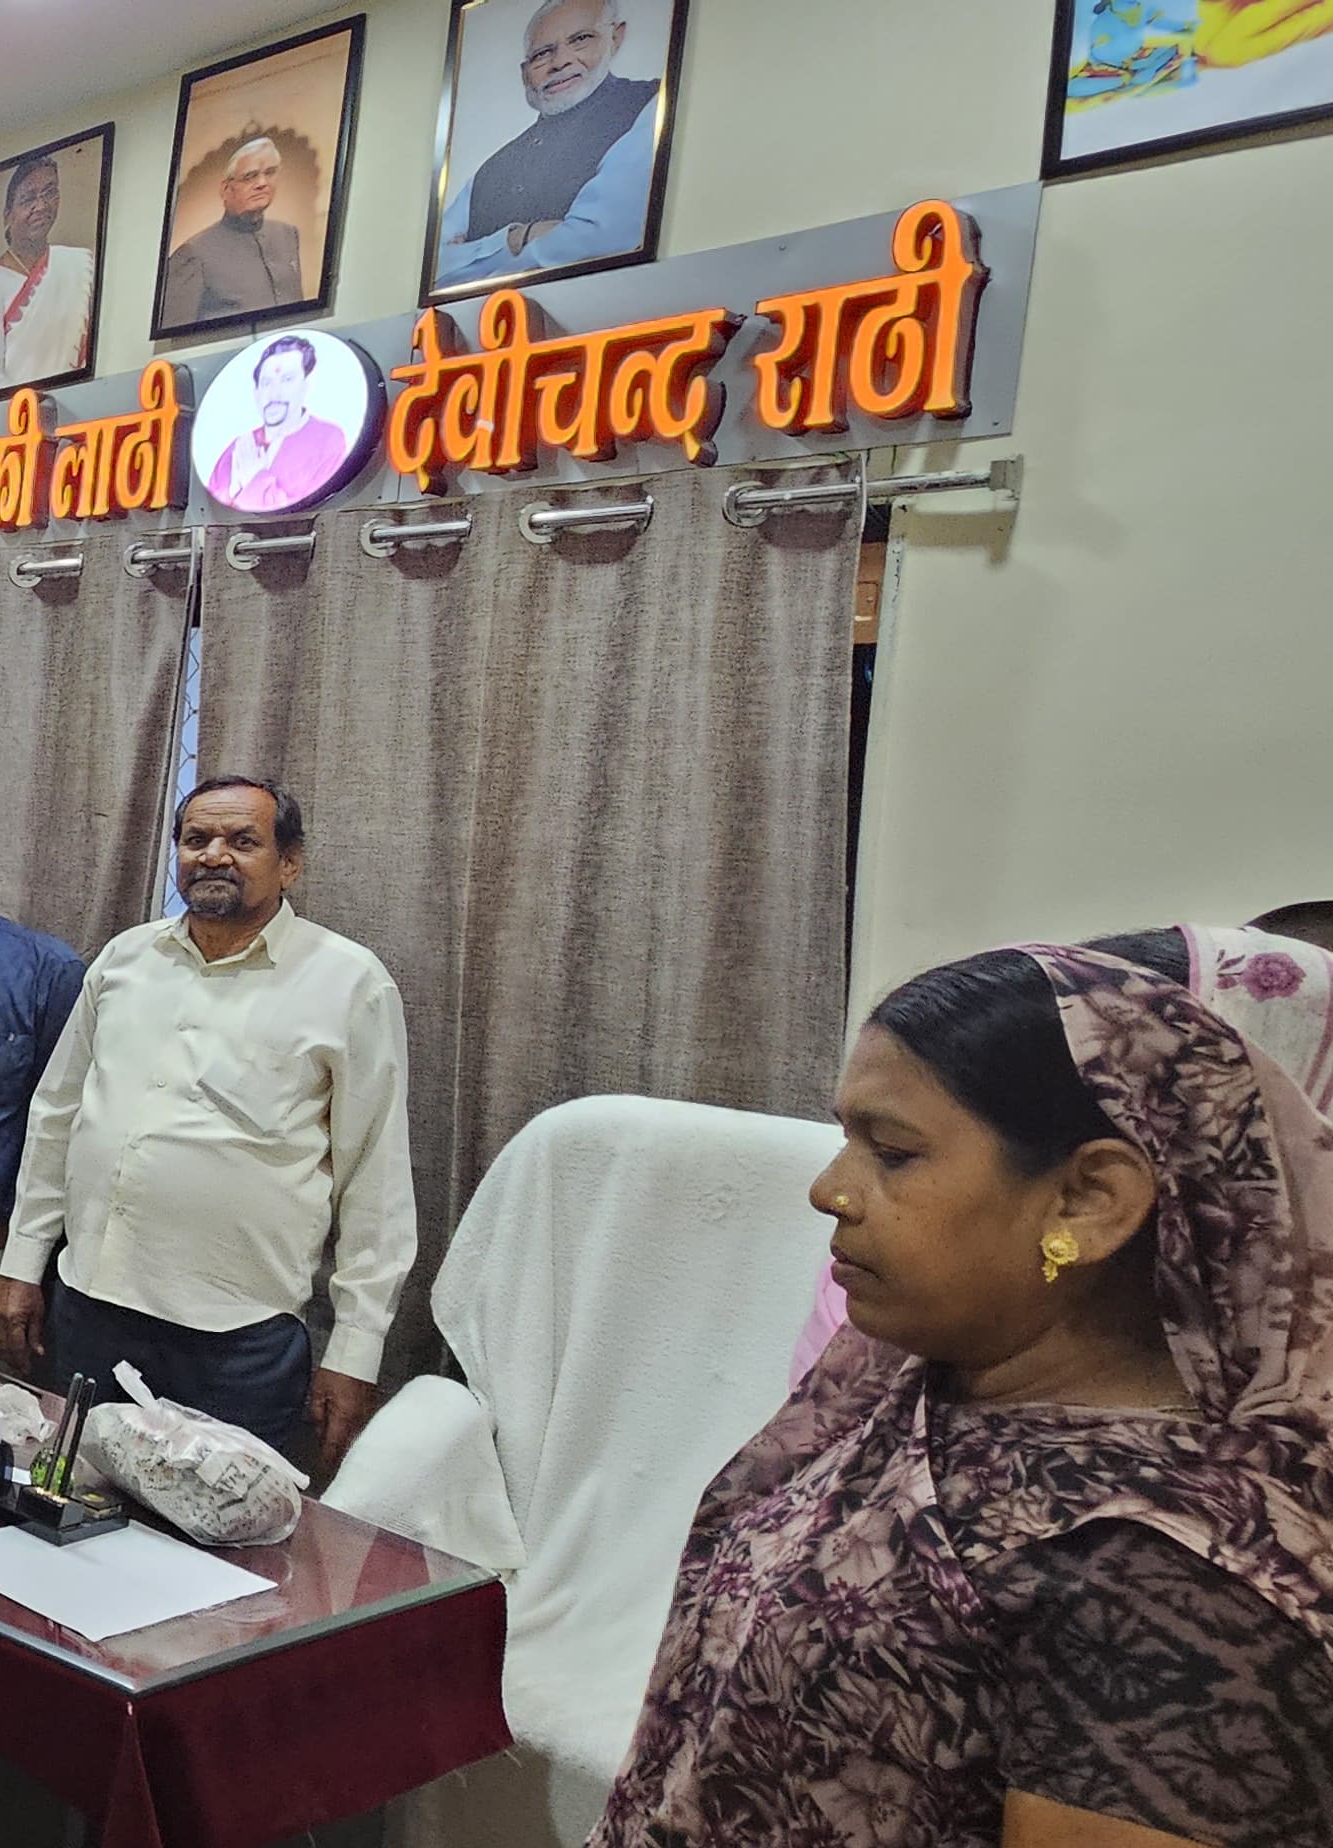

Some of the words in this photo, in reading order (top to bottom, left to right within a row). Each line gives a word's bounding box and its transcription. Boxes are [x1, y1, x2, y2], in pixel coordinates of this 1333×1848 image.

[50, 358, 180, 518] लाठी
[389, 288, 728, 494] देवीचन्द
[754, 199, 974, 435] राठी
